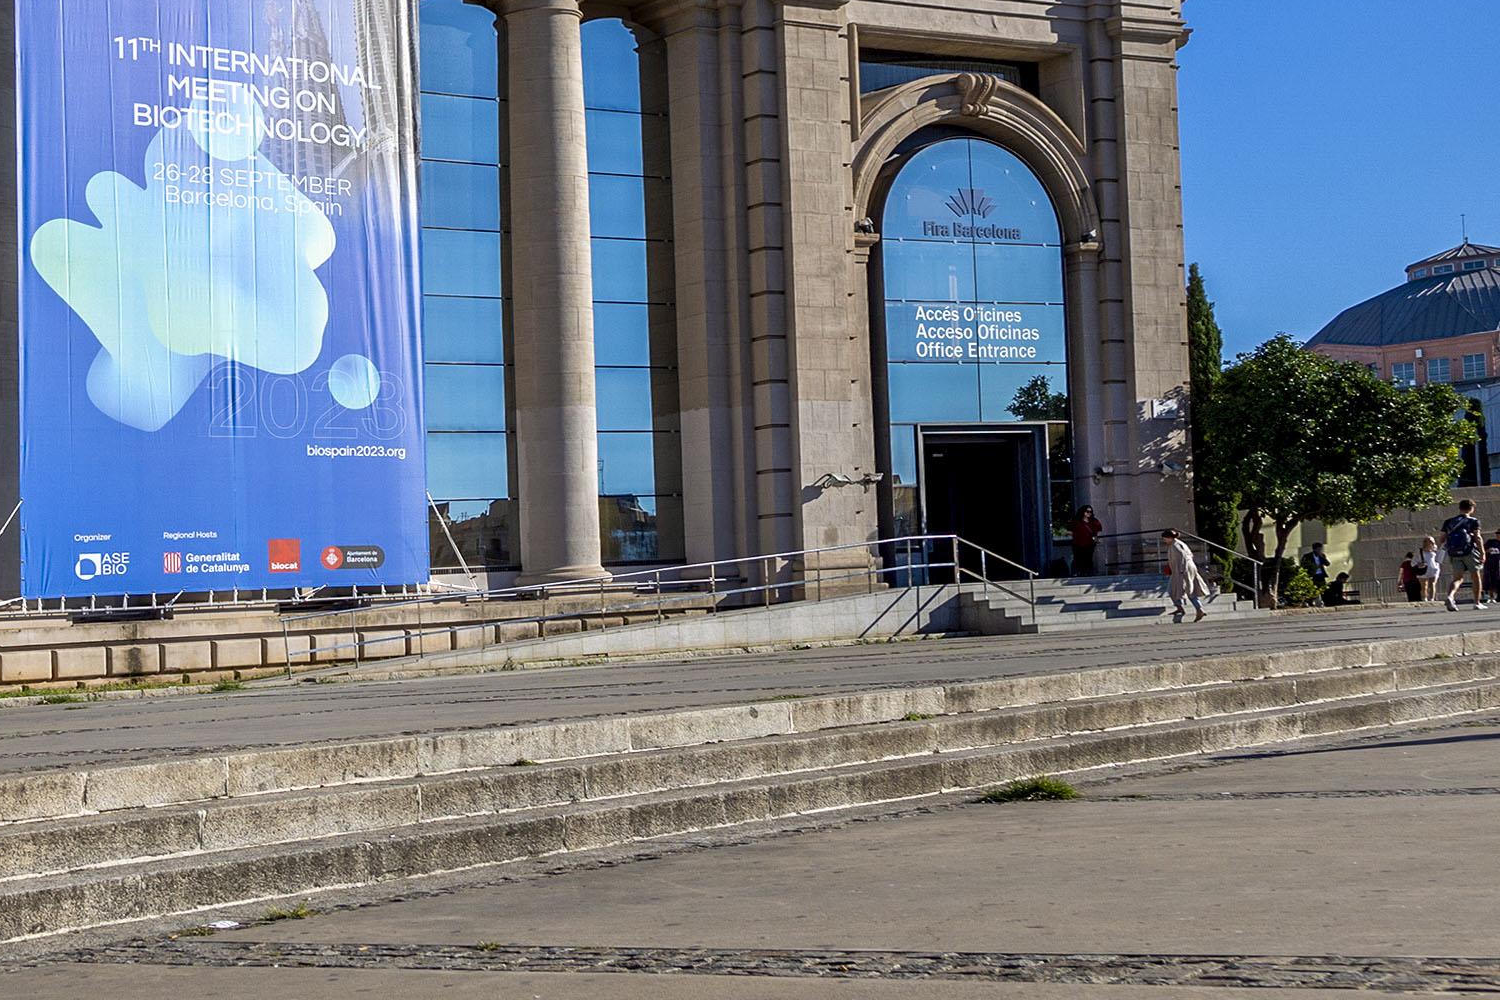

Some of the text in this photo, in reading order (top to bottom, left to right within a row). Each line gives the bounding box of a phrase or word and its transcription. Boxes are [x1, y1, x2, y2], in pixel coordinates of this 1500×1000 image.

[114, 36, 382, 90] 11TH INTERNATIONAL
[168, 74, 336, 115] MEETING ON
[133, 102, 366, 148] BIOTECHNOLOGY
[152, 162, 352, 196] 26-28 SEPTEMBER
[165, 185, 342, 217] Barcelona, Spain
[924, 220, 1021, 240] Fira Barcelona
[915, 305, 960, 321] Accés
[916, 323, 1040, 340] Acceso Oficinas
[916, 342, 1036, 358] Office Entrance
[206, 366, 408, 440] 2023
[306, 444, 406, 460] biospain2023.org
[74, 533, 112, 543] Organizer
[163, 531, 218, 540] Regional Hosts
[101, 552, 130, 564] ASE
[185, 552, 240, 563] Generalitat
[102, 564, 128, 576] BIO
[186, 562, 250, 574] de Catalunya
[271, 562, 298, 570] biocat
